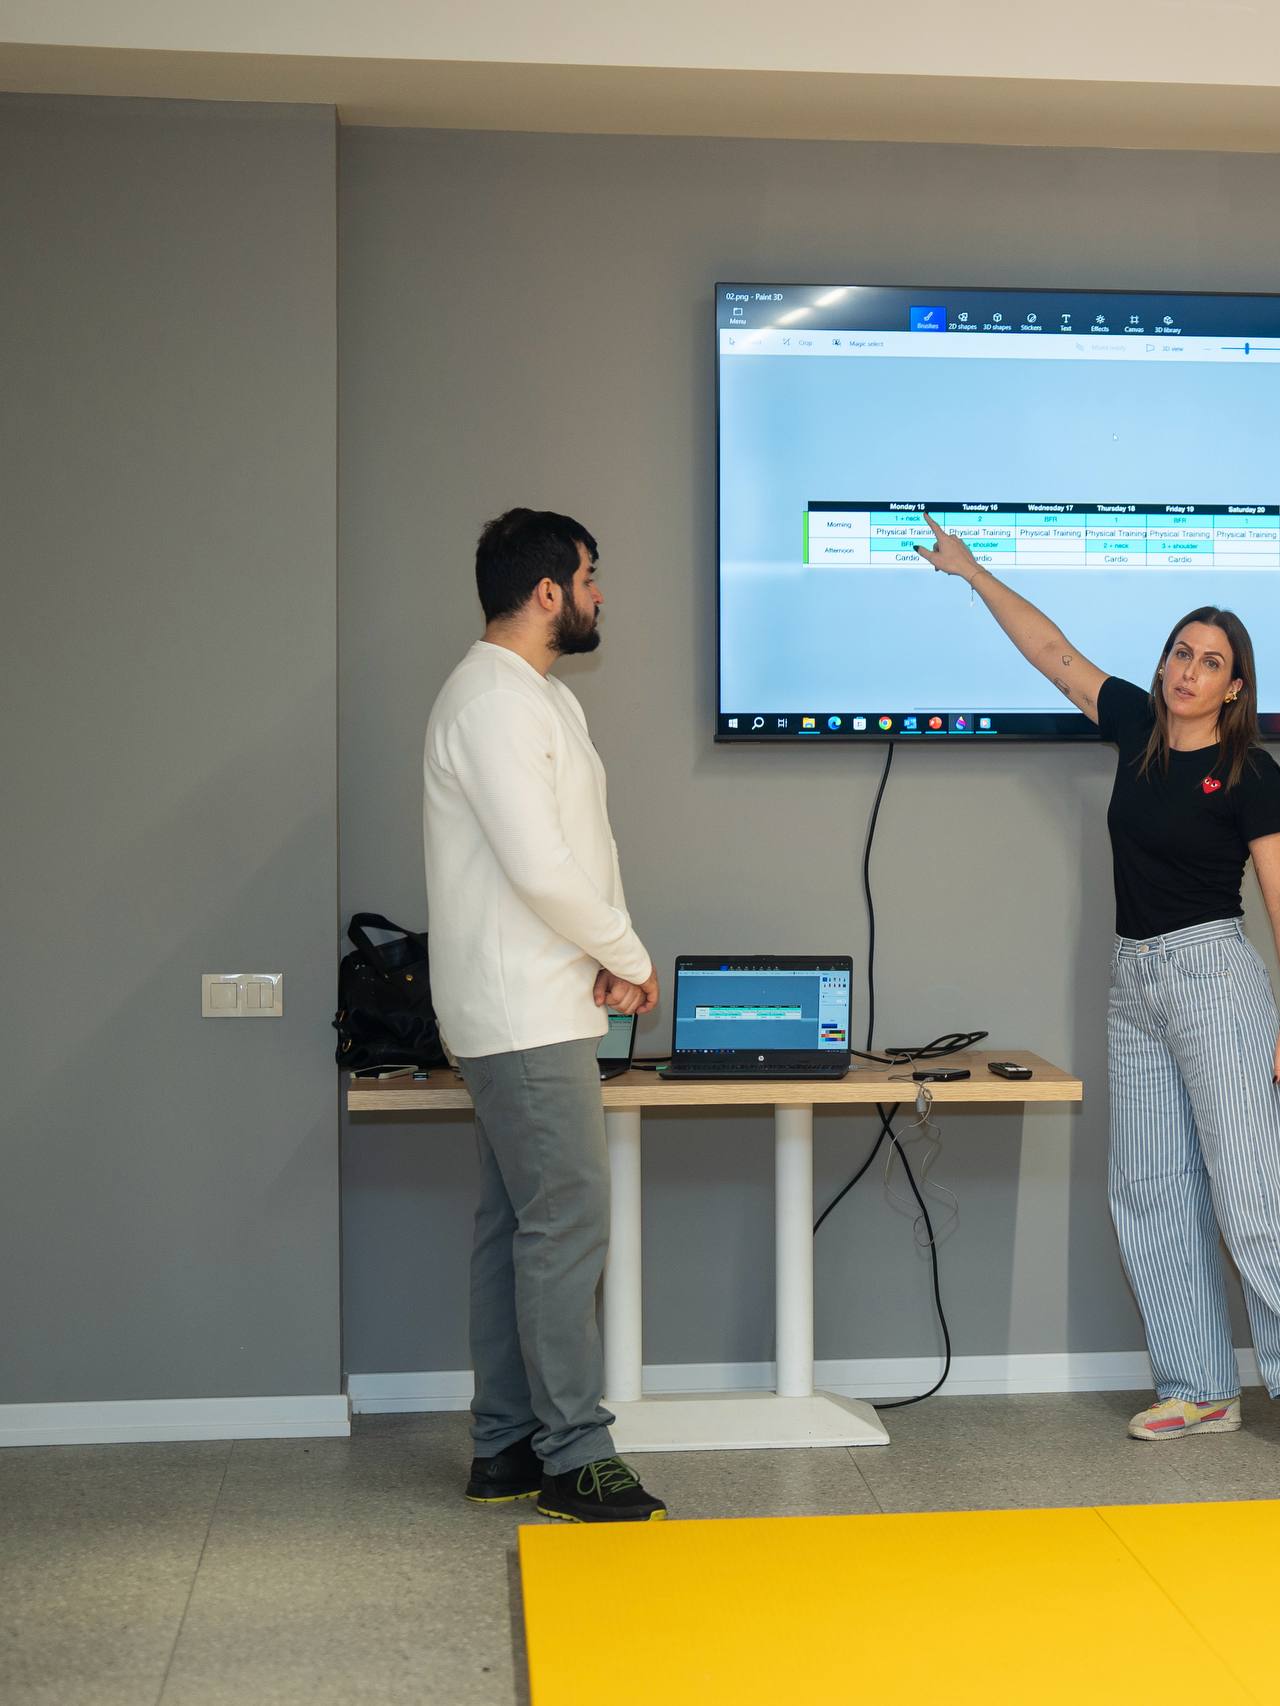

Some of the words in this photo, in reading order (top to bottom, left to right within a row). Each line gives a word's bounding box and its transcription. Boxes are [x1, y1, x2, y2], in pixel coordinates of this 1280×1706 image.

[726, 292, 749, 302] 02.png
[755, 293, 772, 301] Paint
[773, 293, 783, 301] 3D
[958, 323, 977, 331] shapes
[983, 323, 992, 331] 3D
[993, 324, 1012, 332] shapes
[1164, 327, 1181, 335] library
[890, 503, 916, 511] Monday
[877, 528, 907, 536] Physical
[949, 529, 980, 537] Physical
[983, 529, 1011, 537] Training
[1020, 529, 1051, 537] Physical
[1053, 530, 1082, 538] Training
[1119, 530, 1147, 538] Training
[1150, 530, 1179, 538] Physical
[1217, 531, 1246, 539] Physical
[1249, 531, 1277, 539] Training
[1104, 555, 1129, 563] Cardio
[1168, 555, 1193, 563] Cardio
